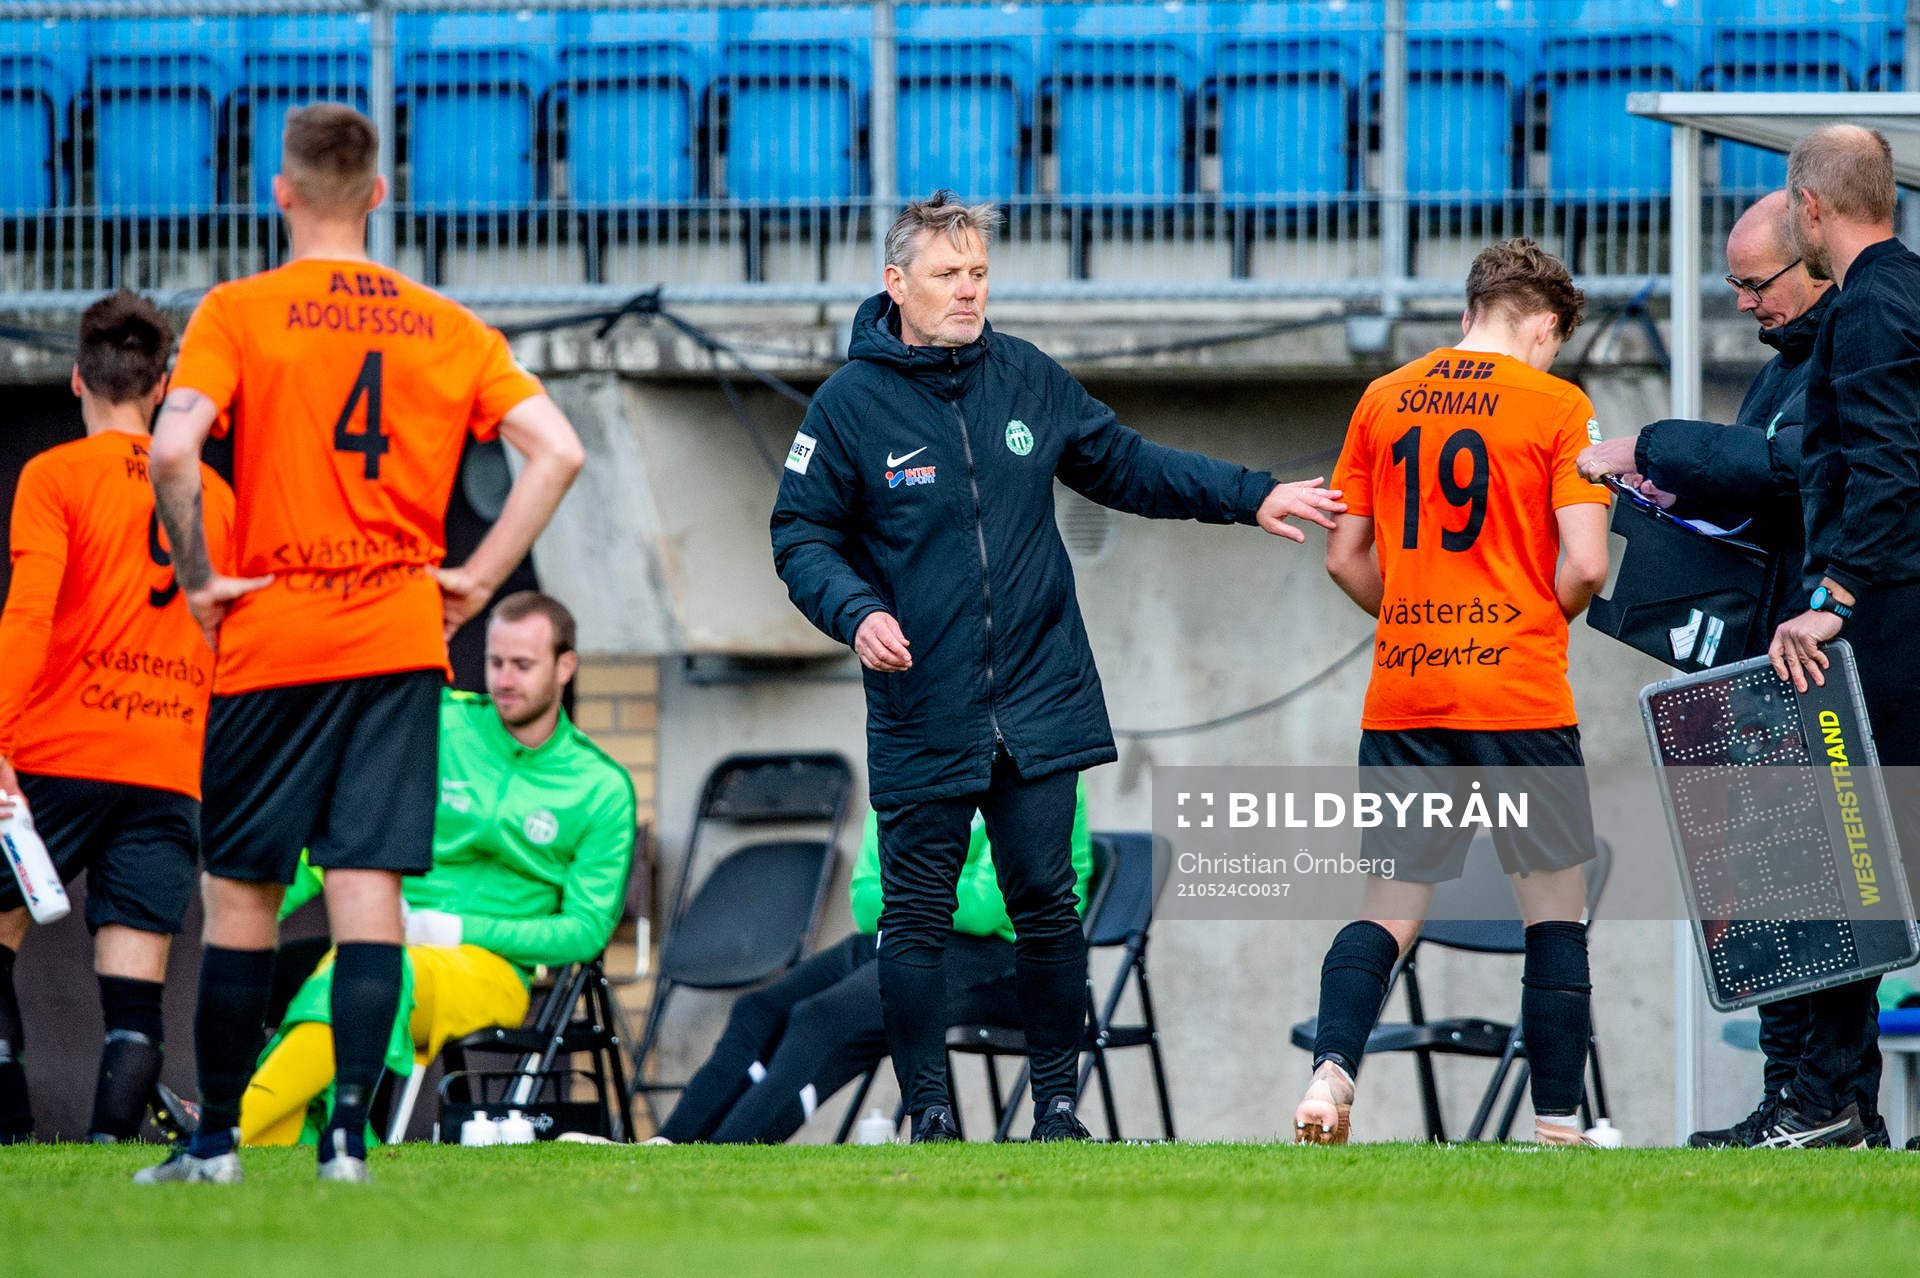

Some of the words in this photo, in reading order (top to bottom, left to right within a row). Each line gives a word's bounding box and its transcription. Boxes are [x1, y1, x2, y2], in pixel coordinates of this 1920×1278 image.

[330, 271, 399, 297] ABB
[287, 301, 435, 341] ADOLFSSON
[1425, 359, 1496, 380] ABB
[334, 351, 389, 480] 4
[1397, 384, 1499, 416] SÖRMAN
[904, 465, 936, 478] INTER
[1391, 425, 1490, 553] 19
[1378, 637, 1511, 677] Carpenter
[1818, 710, 1881, 907] WESTERSTRAND
